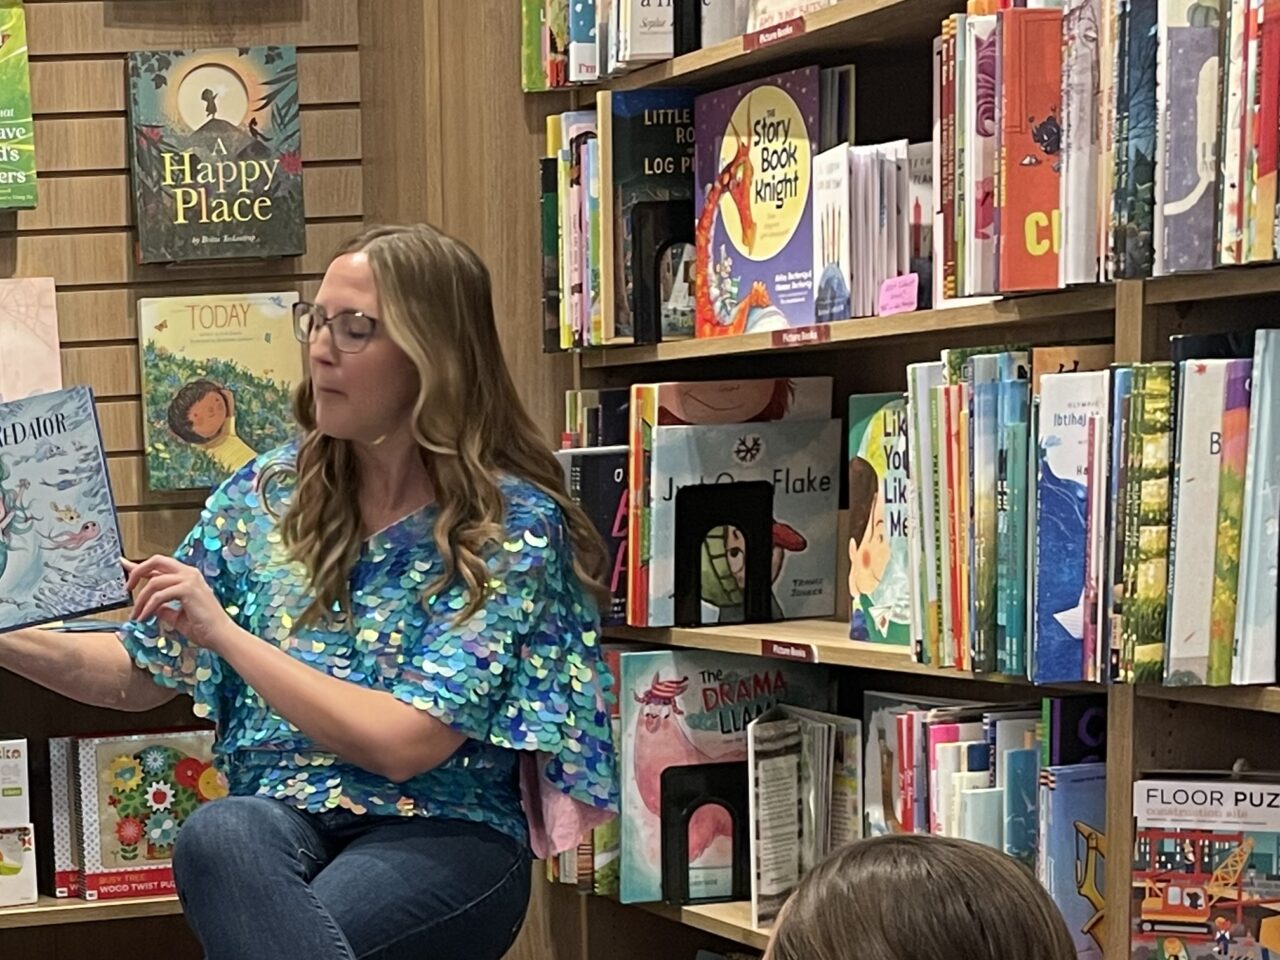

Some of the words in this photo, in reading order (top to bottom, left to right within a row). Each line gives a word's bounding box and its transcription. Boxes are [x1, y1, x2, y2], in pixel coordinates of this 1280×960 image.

[643, 109, 691, 126] LITTLE
[754, 117, 791, 147] Story
[211, 137, 228, 156] A
[644, 157, 675, 175] LOG
[761, 144, 798, 173] Book
[160, 147, 280, 194] Happy
[172, 187, 273, 225] Place
[184, 303, 252, 331] TODAY
[783, 331, 801, 343] Picture
[772, 467, 832, 495] Flake
[698, 669, 724, 684] The
[702, 670, 788, 713] DRAMA
[1145, 788, 1224, 807] FLOOR
[1146, 806, 1222, 819] construction
[1226, 808, 1248, 819] site
[124, 873, 146, 882] TREE
[100, 883, 129, 894] WOOD
[131, 881, 159, 892] TWIST
